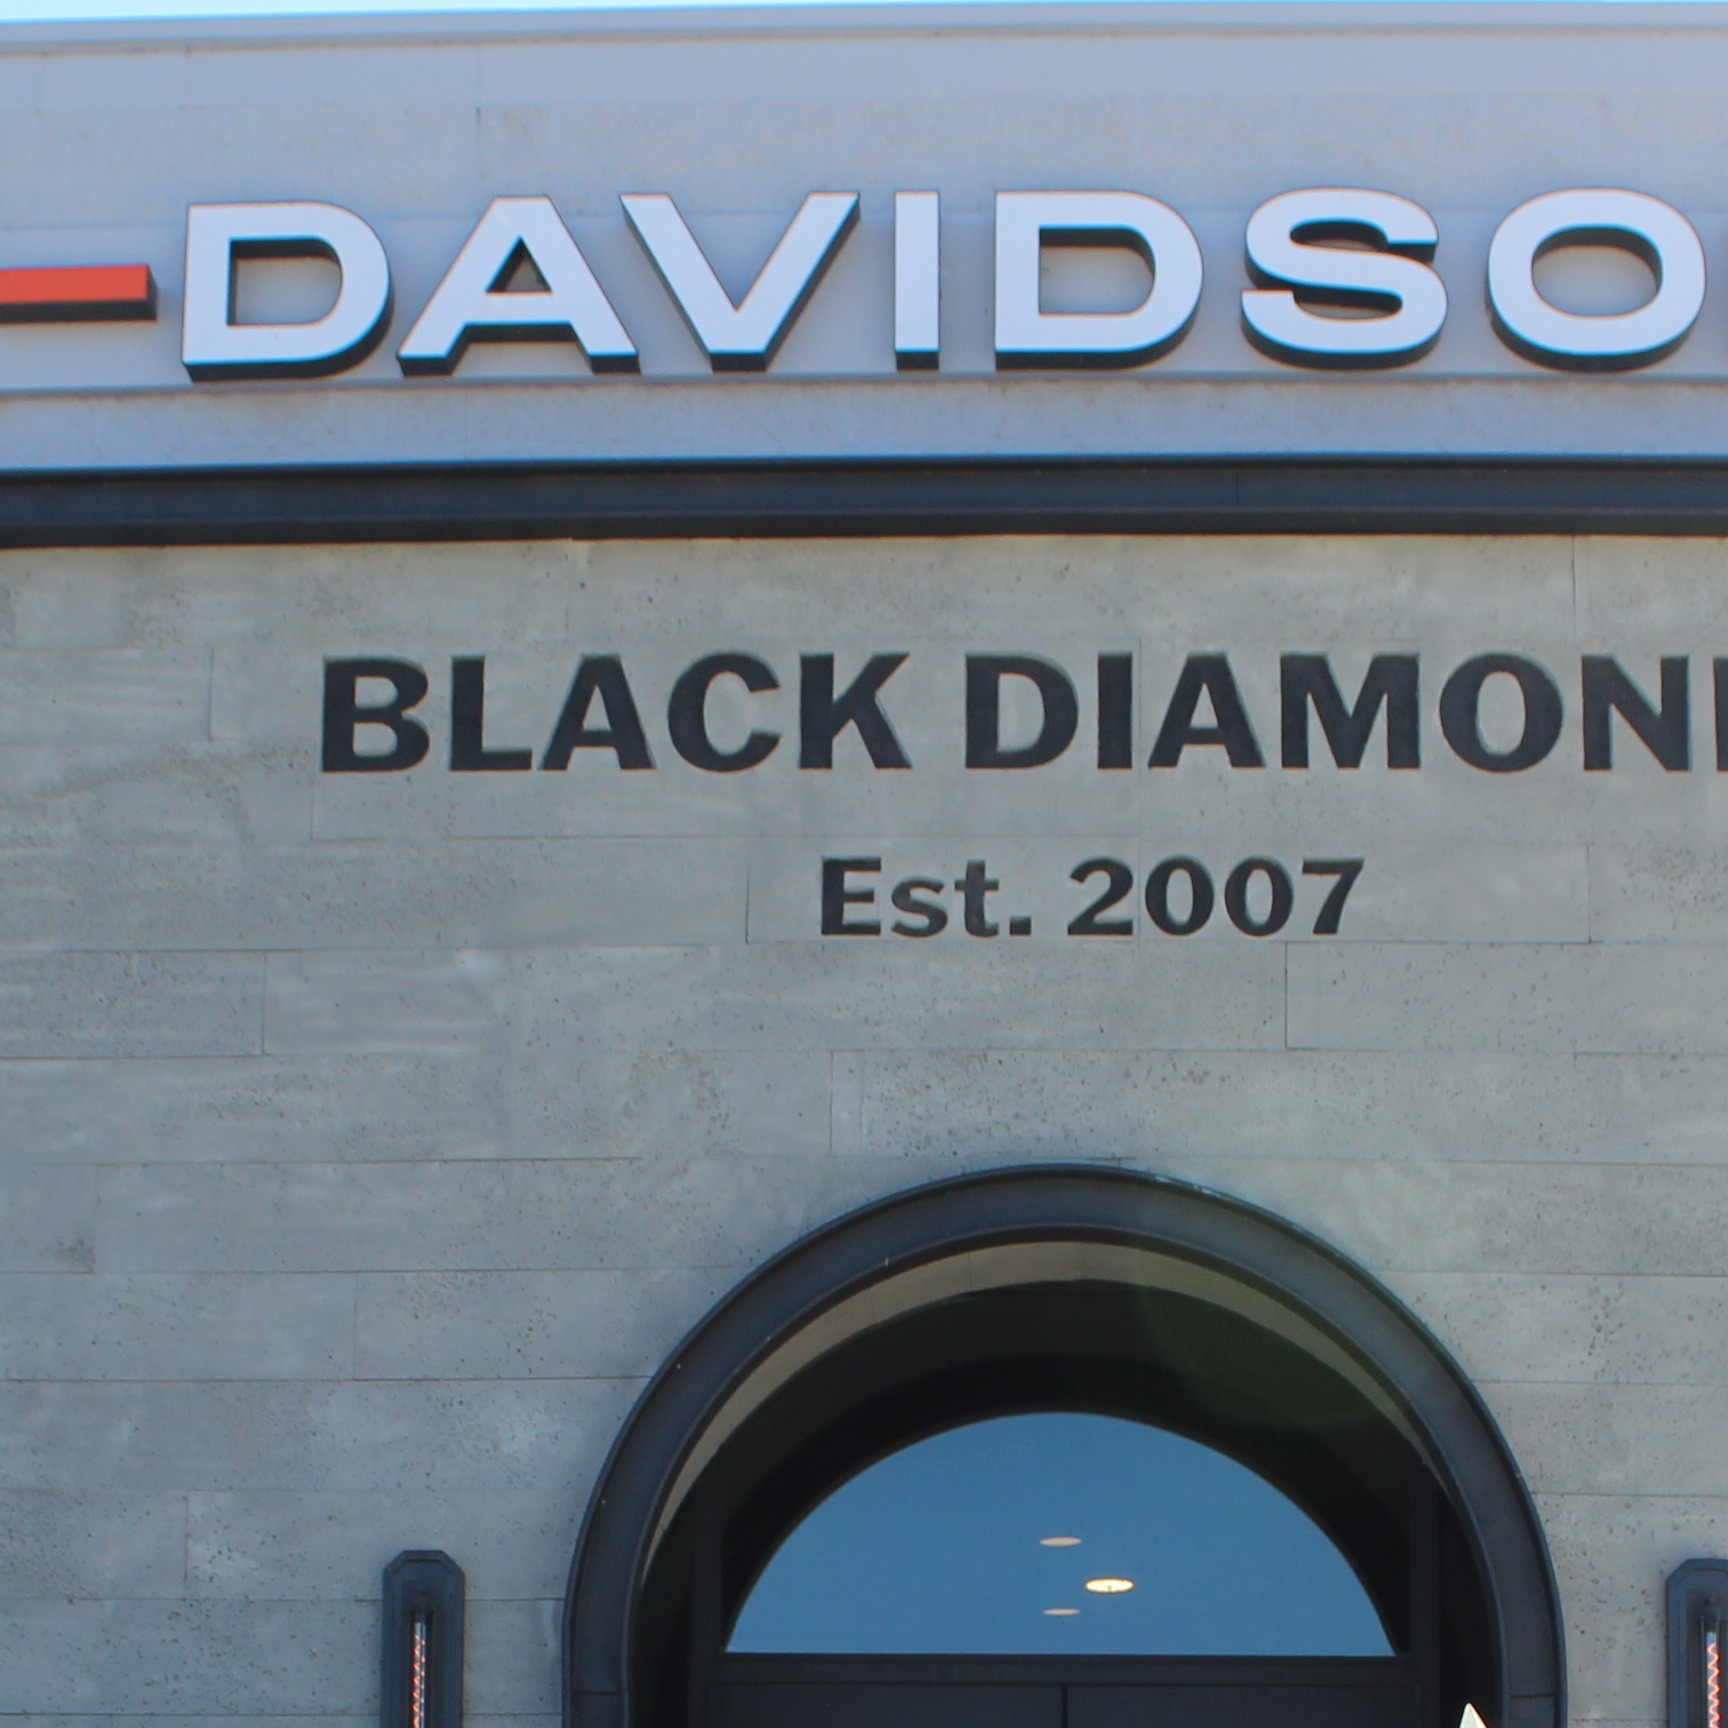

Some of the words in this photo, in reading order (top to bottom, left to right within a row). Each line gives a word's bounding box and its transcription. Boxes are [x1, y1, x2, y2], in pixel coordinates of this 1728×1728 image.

[320, 652, 914, 774] BLACK
[821, 856, 1033, 938] Est.
[1066, 856, 1366, 938] 2007
